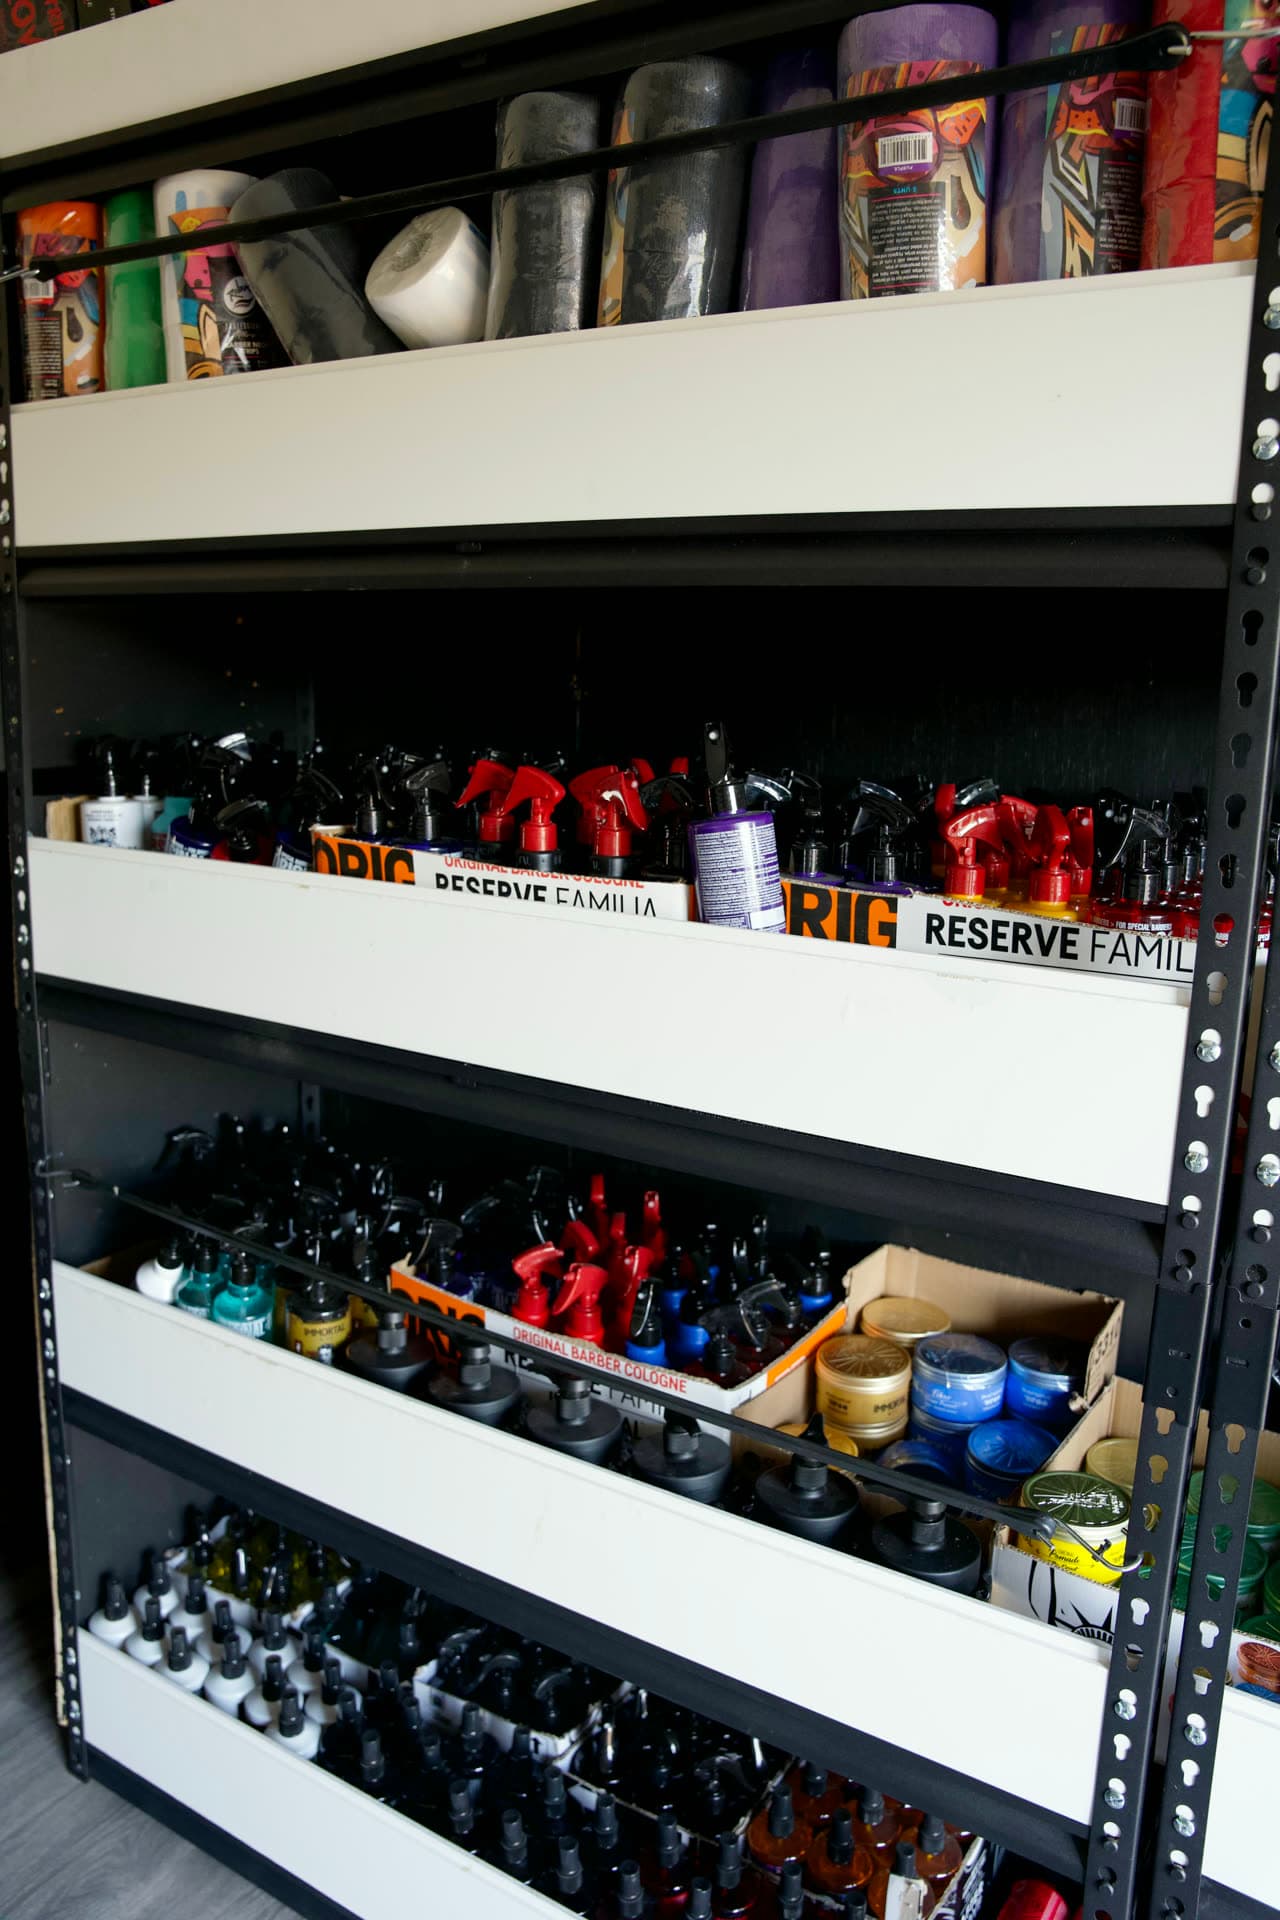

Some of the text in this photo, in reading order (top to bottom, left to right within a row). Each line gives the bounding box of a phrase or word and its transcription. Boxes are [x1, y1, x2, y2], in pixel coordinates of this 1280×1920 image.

[781, 884, 898, 949] RIG
[925, 912, 1194, 973] RESERVE FAMIL
[1127, 922, 1150, 931] SPECIAL
[304, 1323, 345, 1337] IMMORTAL
[513, 1326, 569, 1357] ORIGINAL
[571, 1346, 622, 1374] BARBER
[624, 1363, 688, 1394] COLOGNE
